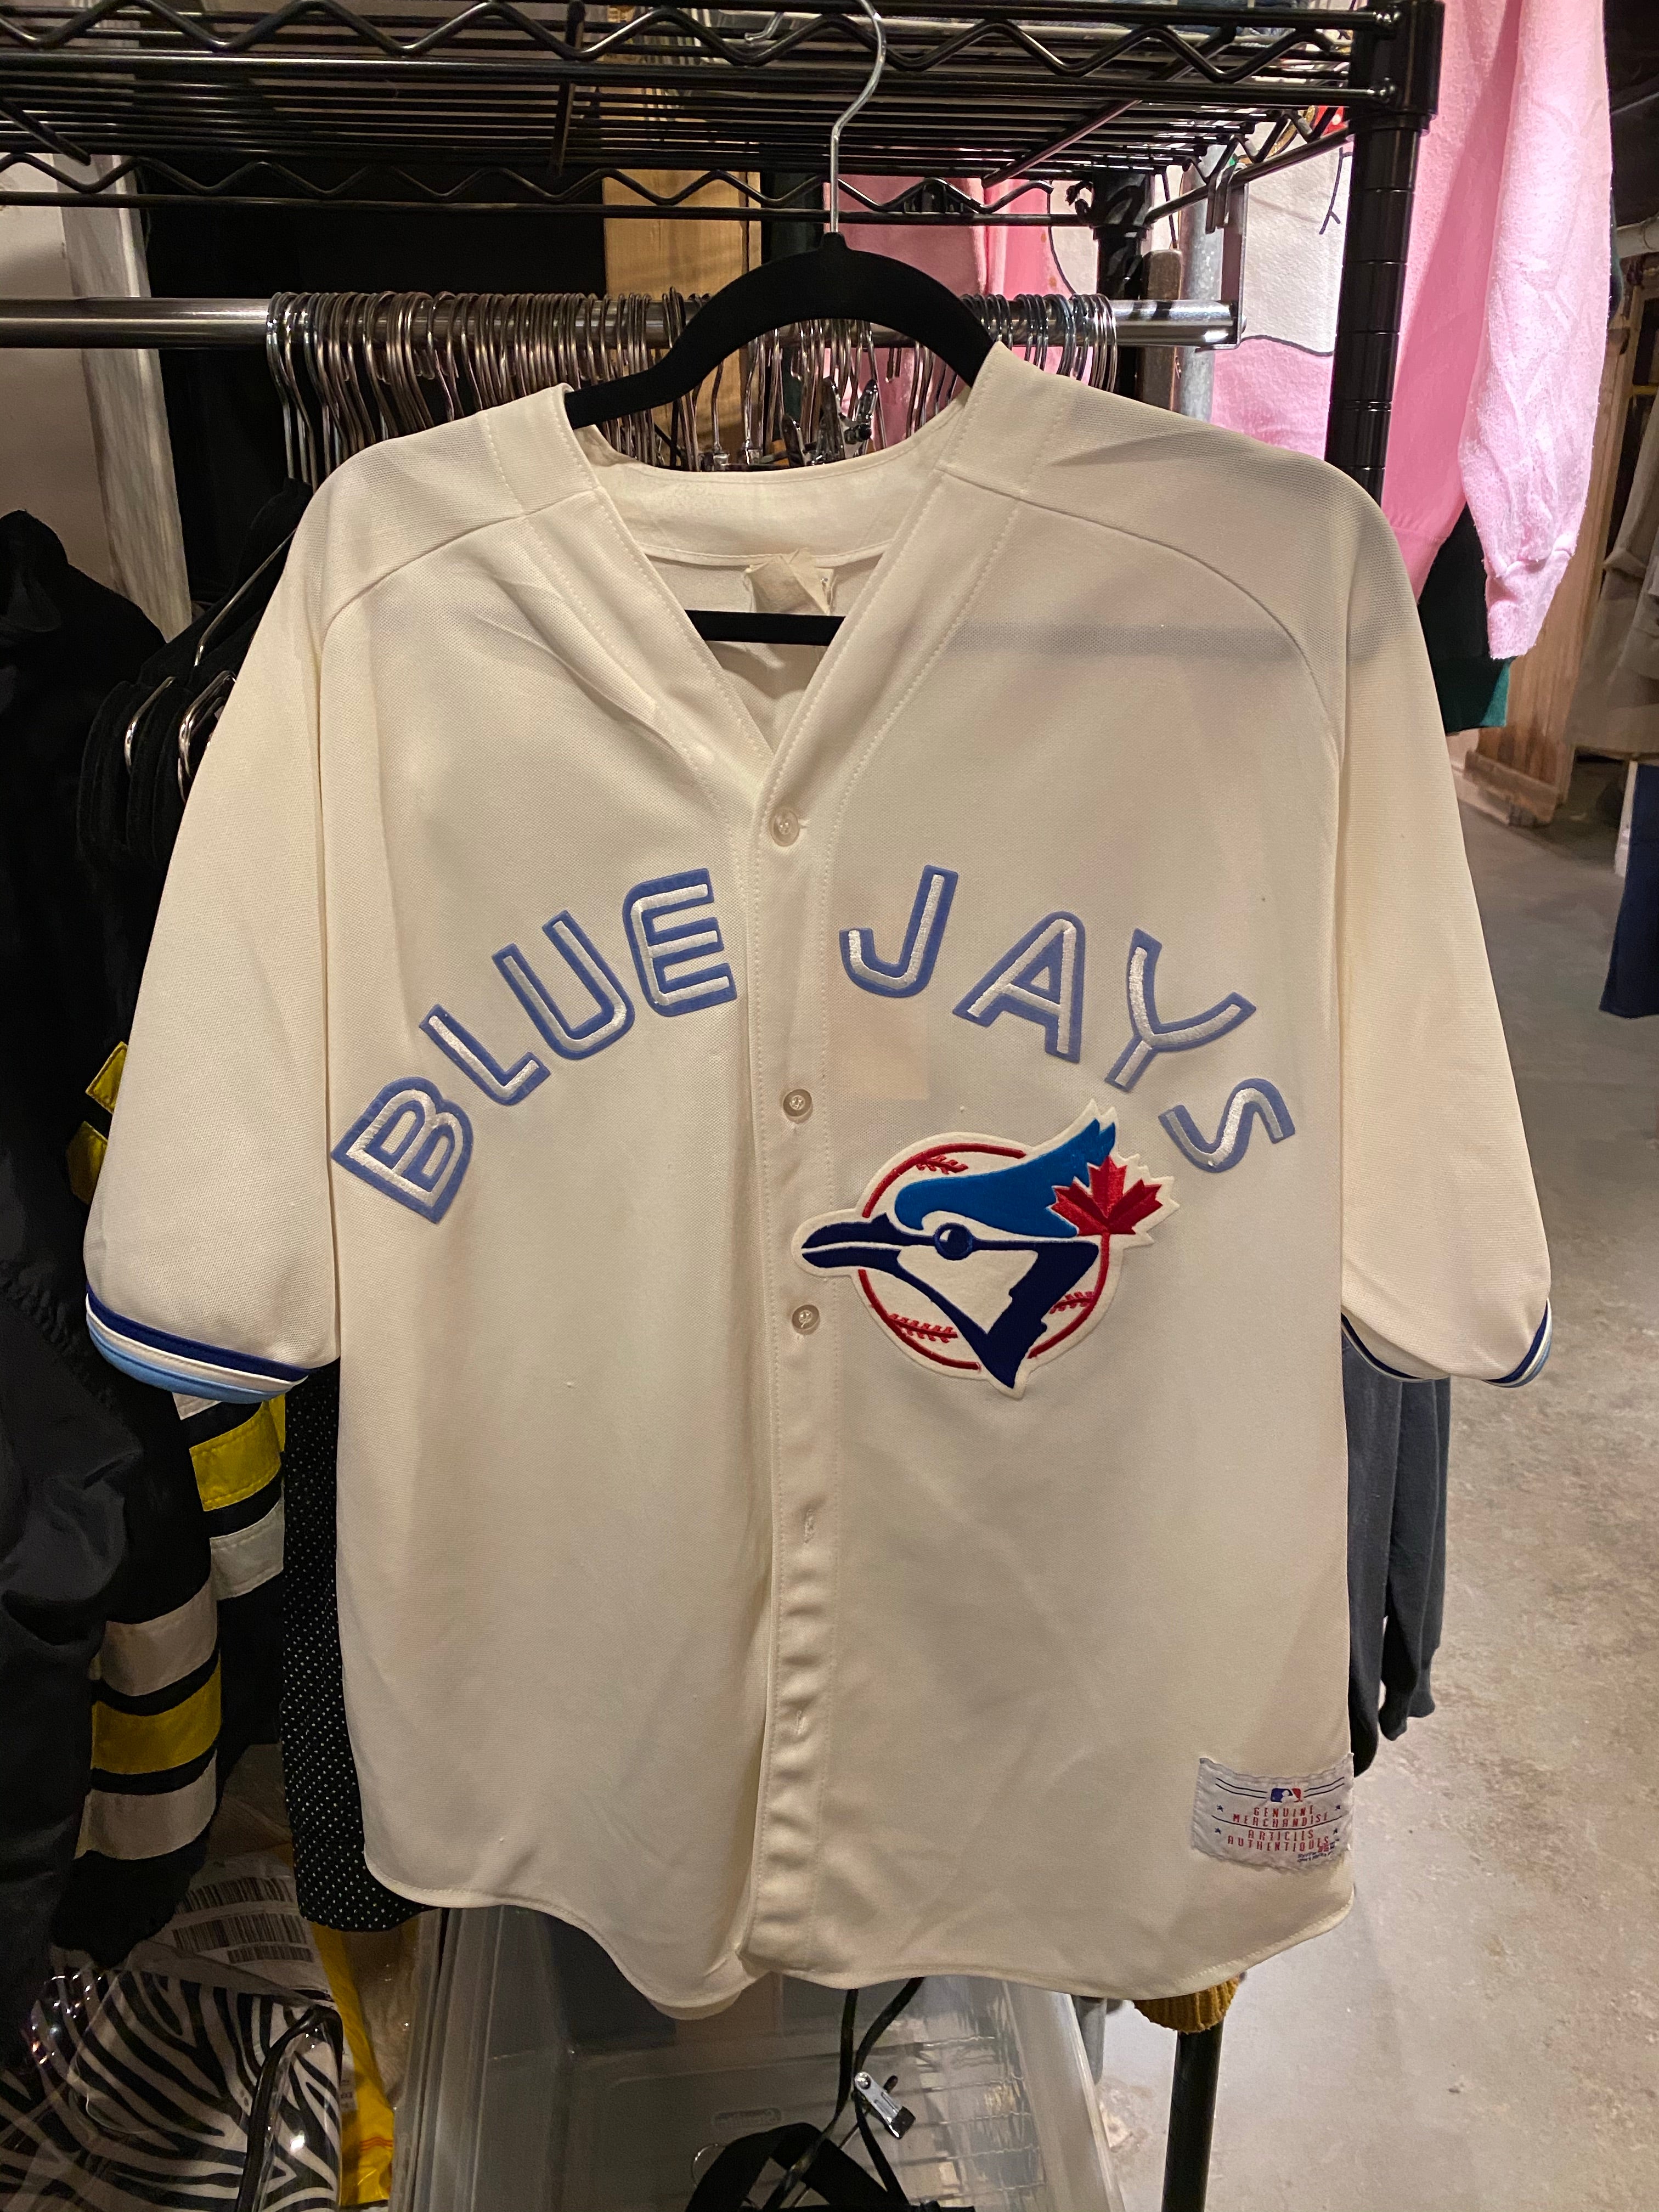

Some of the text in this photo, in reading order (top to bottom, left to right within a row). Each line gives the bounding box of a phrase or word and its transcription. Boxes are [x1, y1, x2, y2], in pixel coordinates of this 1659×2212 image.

[330, 865, 1295, 1224] BLUE JAYS
[1254, 1805, 1313, 1818] GENUINE
[1233, 1812, 1328, 1828] MERCHANDISE
[1248, 1829, 1314, 1841] ARTICLES
